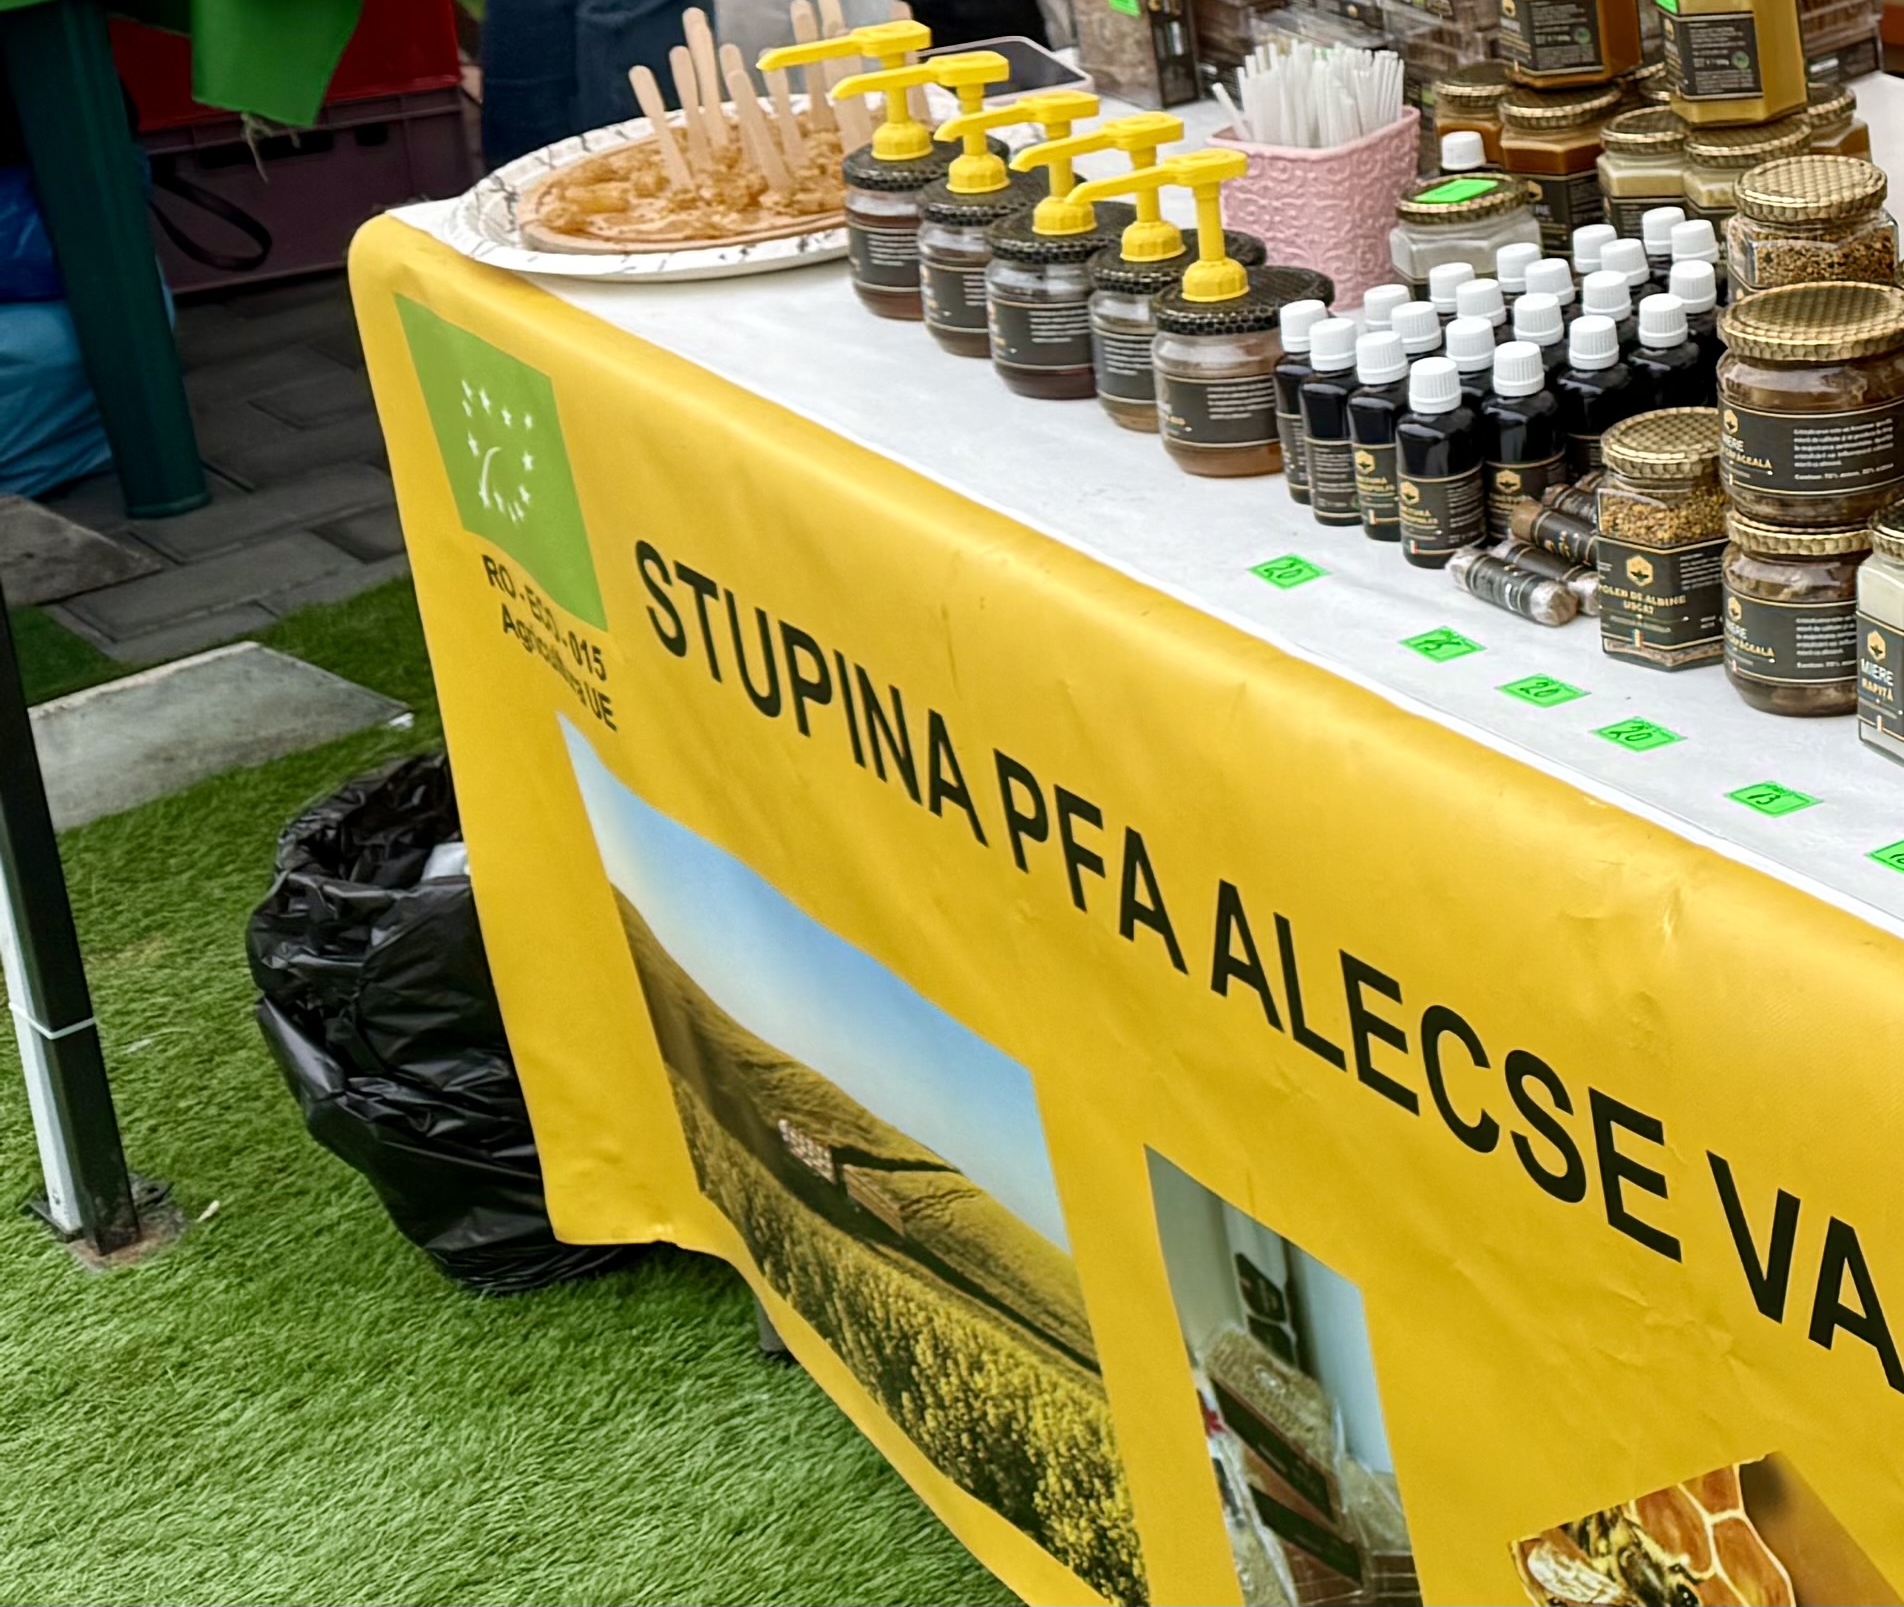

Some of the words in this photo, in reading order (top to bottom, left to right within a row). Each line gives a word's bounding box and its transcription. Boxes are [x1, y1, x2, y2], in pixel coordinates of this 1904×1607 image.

[1861, 658, 1894, 686] MIERE
[635, 539, 988, 848] STUPINA
[993, 748, 1189, 976] PFA
[1211, 878, 1683, 1264] ALECSE
